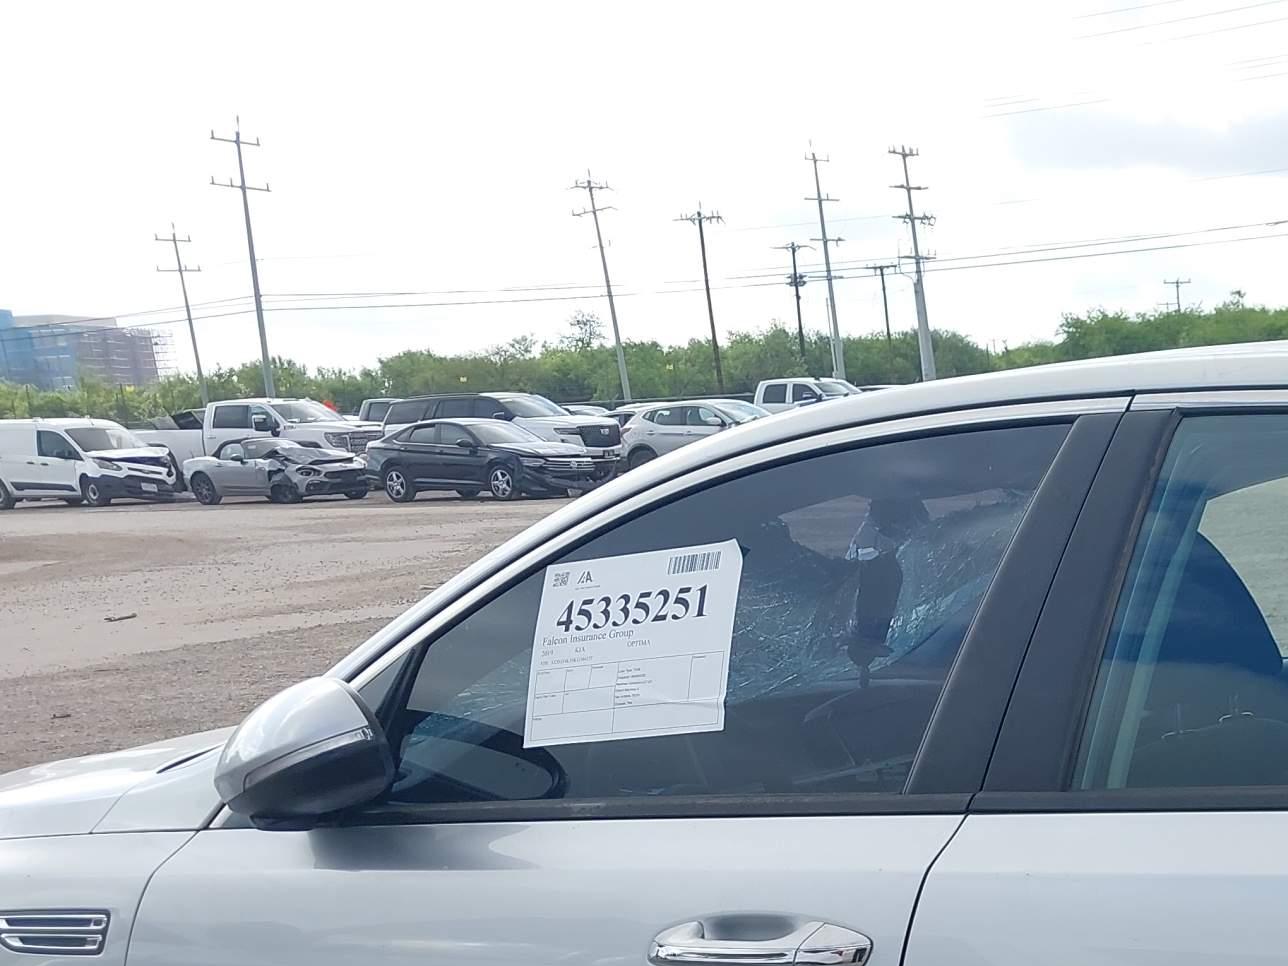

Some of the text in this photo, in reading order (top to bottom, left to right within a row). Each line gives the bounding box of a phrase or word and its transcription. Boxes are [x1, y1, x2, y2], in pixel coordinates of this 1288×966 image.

[556, 584, 708, 632] 45335251
[542, 629, 634, 647] Falcon Insurance Group
[626, 639, 652, 648] OPTIMA
